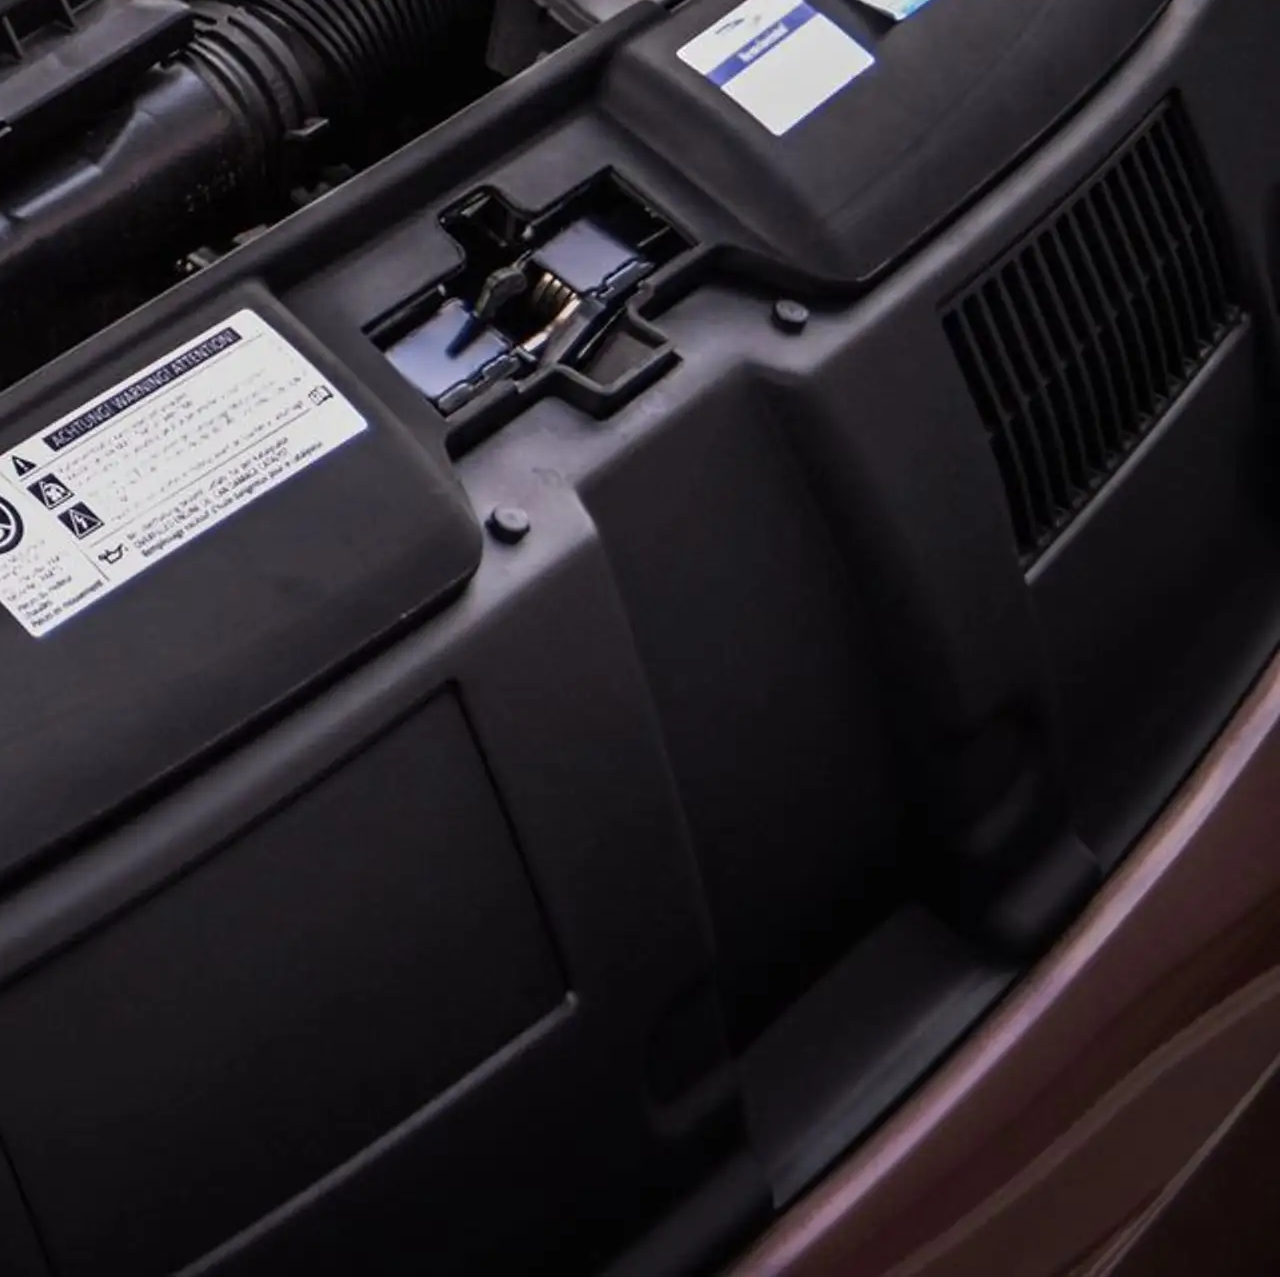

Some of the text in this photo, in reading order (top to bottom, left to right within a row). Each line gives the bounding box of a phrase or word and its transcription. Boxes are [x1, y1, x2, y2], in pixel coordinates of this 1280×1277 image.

[50, 402, 114, 447] ACHTUNG!
[112, 369, 169, 410] WARNING!
[171, 328, 236, 374] ATTENTION!
